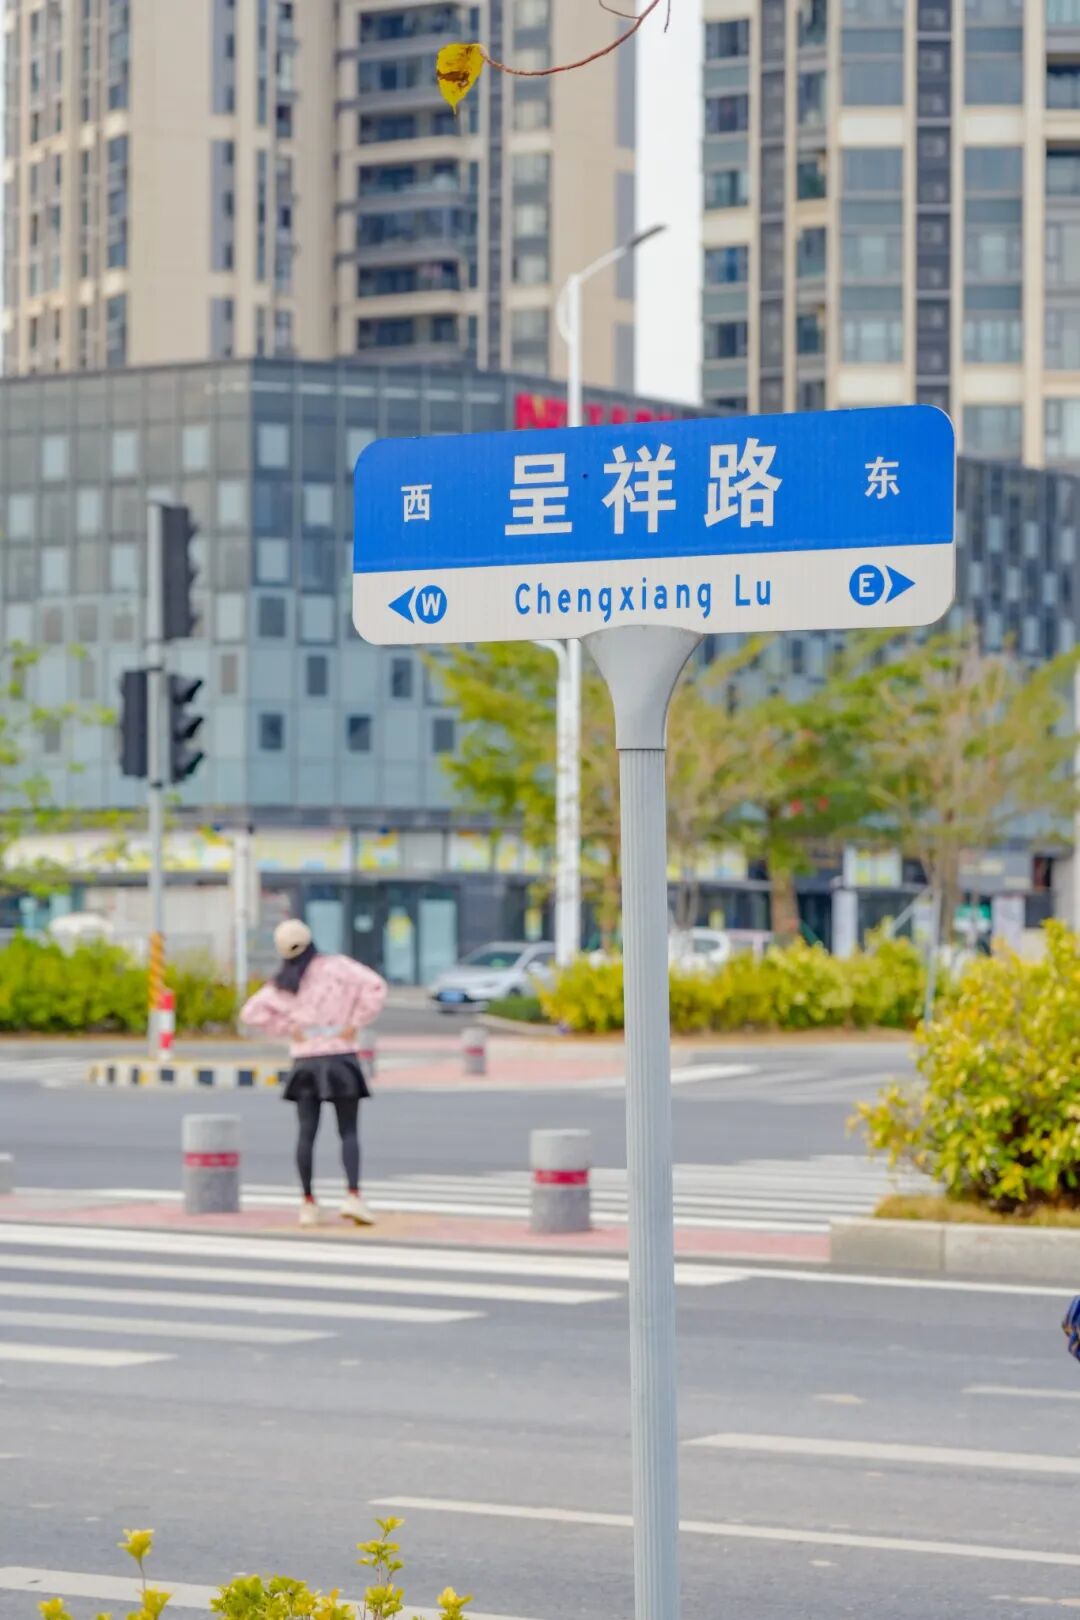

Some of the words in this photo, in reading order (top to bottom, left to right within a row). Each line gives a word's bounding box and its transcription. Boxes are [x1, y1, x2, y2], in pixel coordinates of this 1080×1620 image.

[504, 437, 783, 537] 呈祥路
[864, 456, 900, 500] 东
[401, 483, 432, 523] 西
[421, 592, 442, 617] W
[515, 578, 713, 623] Chengxiang
[735, 575, 772, 607] Lu
[858, 572, 876, 598] E
